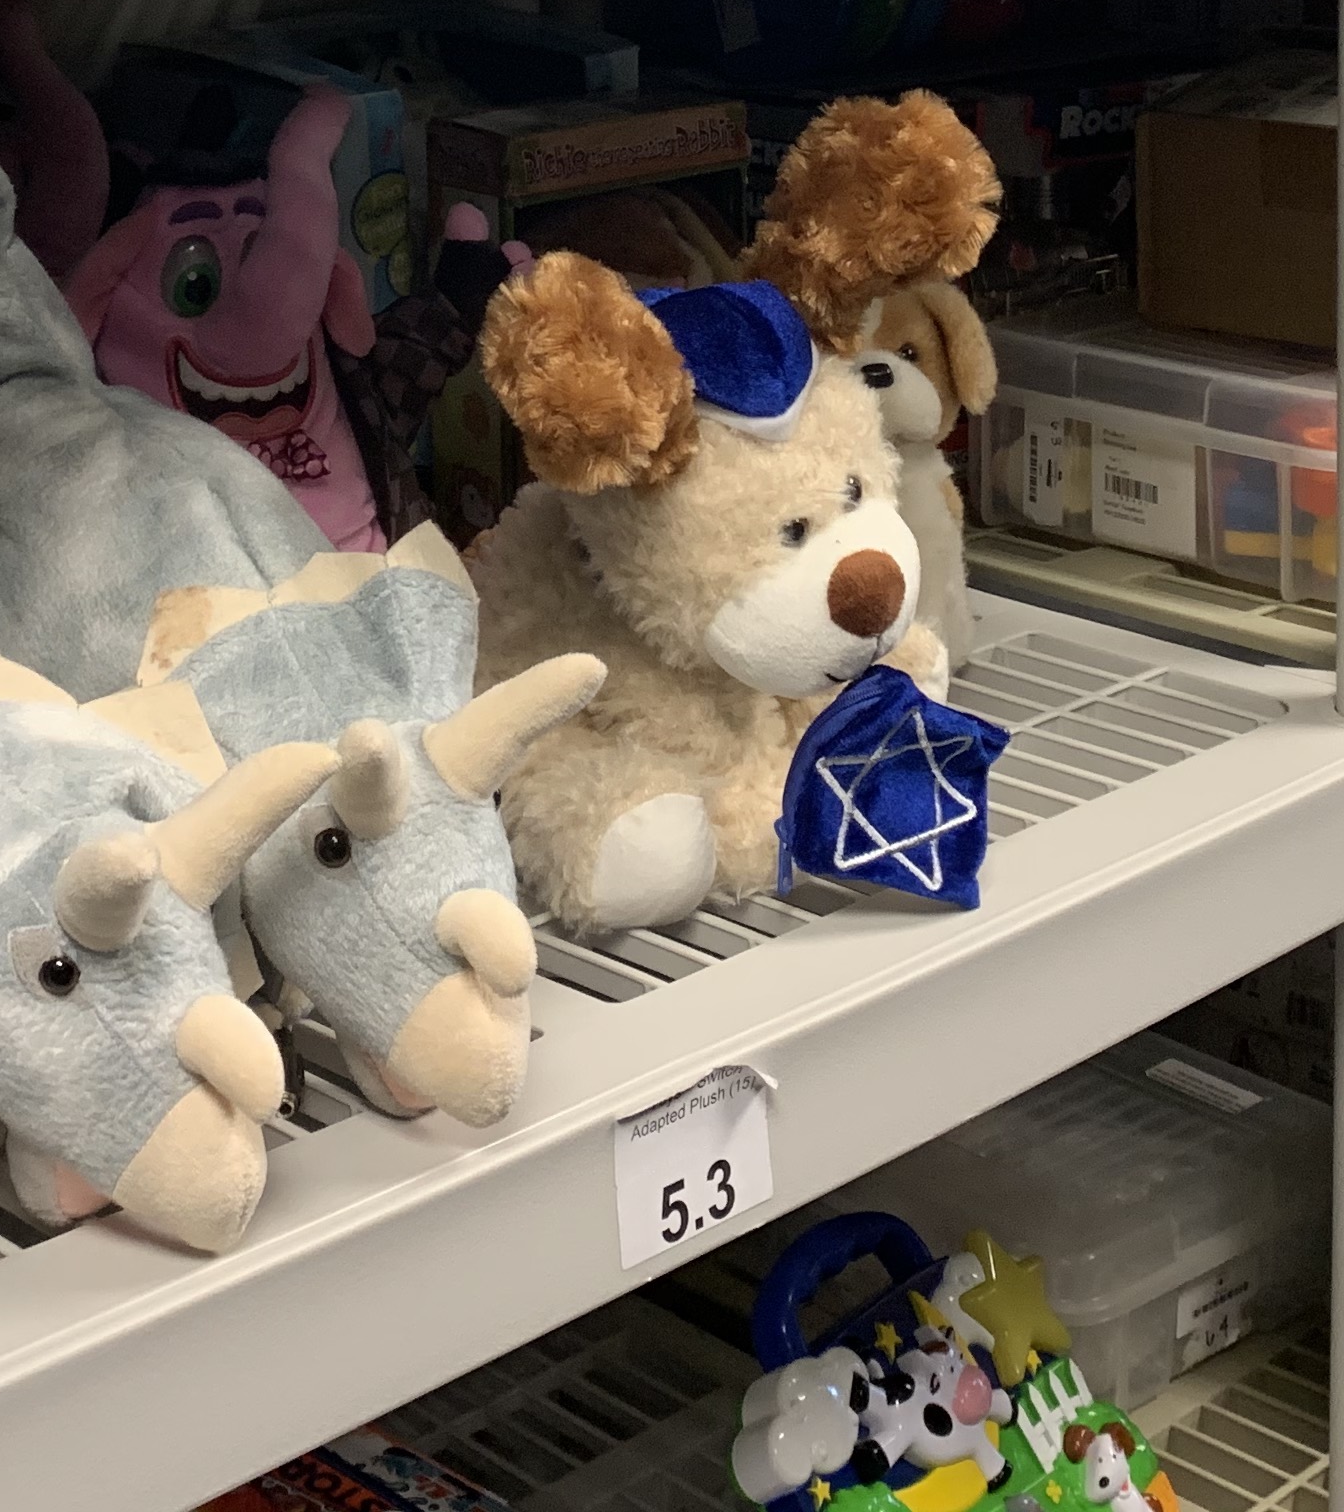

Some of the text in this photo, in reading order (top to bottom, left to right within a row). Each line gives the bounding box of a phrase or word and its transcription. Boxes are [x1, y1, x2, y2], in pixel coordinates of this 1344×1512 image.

[630, 1104, 686, 1142] Adapted
[689, 1089, 726, 1115] Plush
[660, 1158, 736, 1244] 5.3
